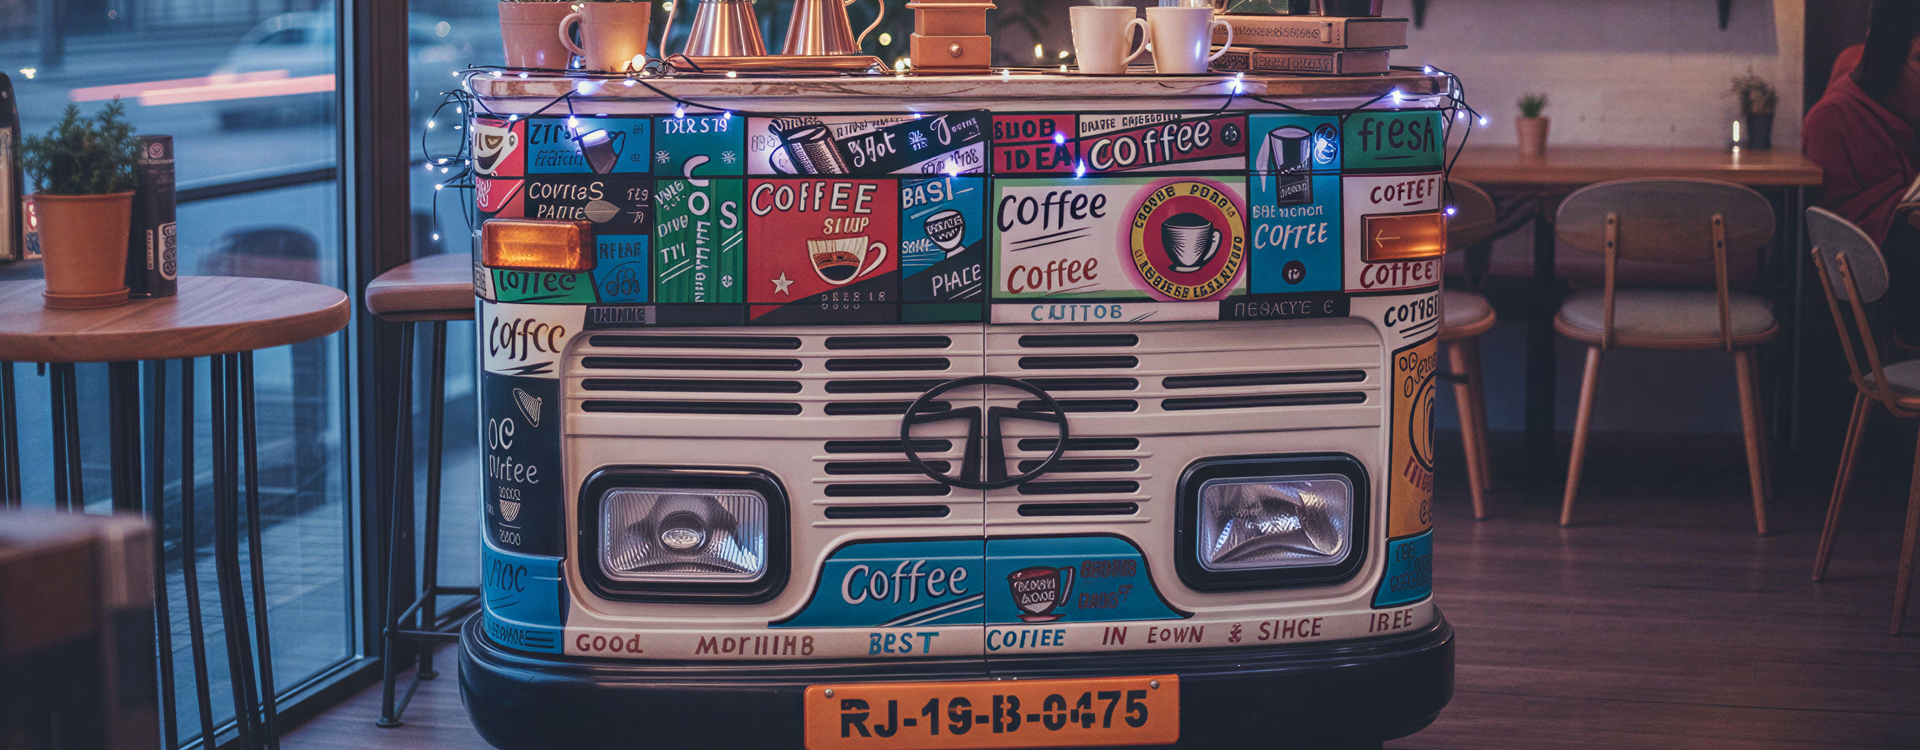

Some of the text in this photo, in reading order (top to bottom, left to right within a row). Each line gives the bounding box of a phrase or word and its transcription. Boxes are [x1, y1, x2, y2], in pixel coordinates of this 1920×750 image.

[751, 181, 877, 216] COFFEE
[997, 190, 1107, 232] Coffee
[841, 559, 968, 605] Coffee
[1102, 626, 1128, 646] IN
